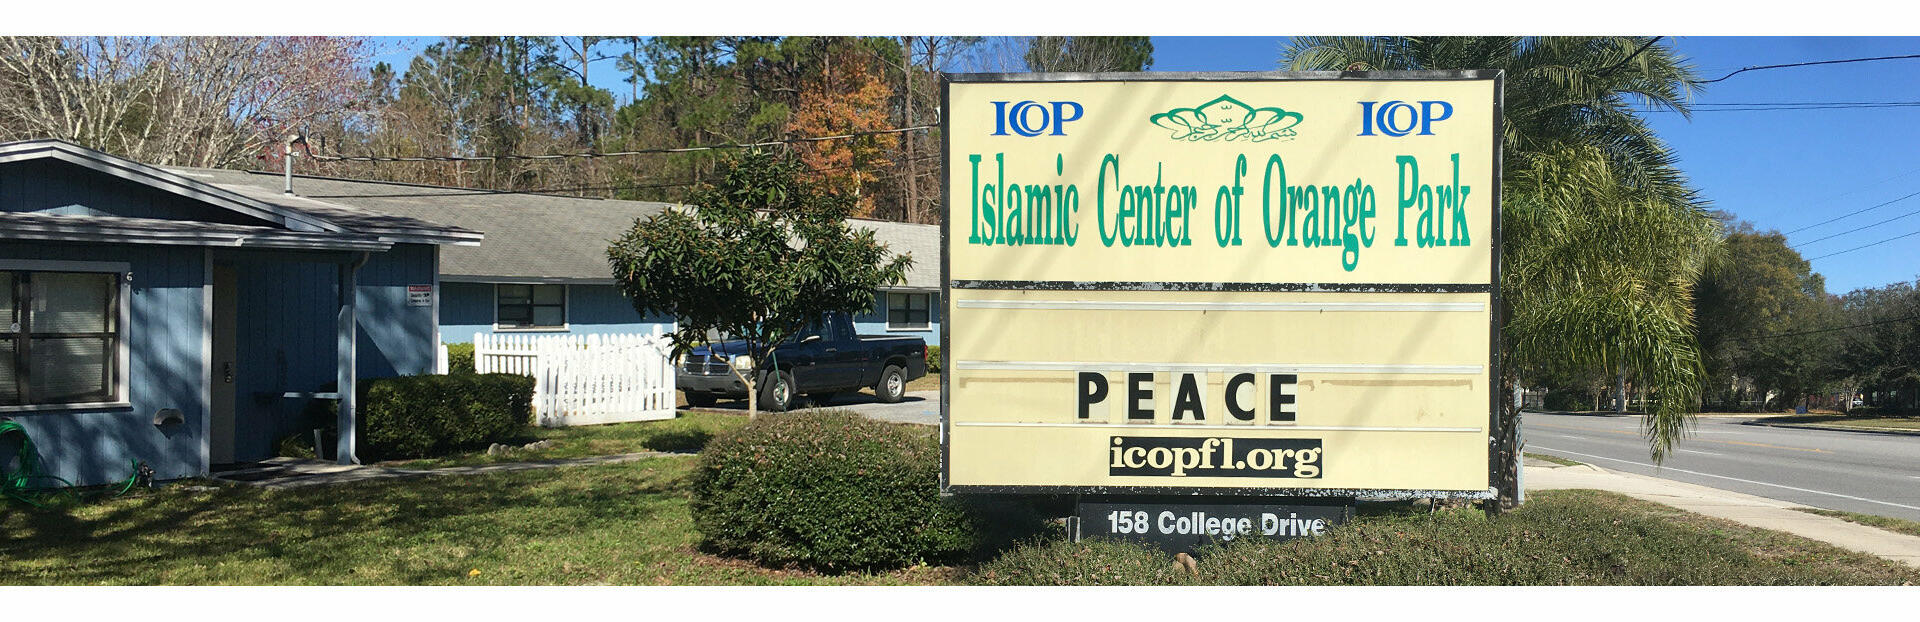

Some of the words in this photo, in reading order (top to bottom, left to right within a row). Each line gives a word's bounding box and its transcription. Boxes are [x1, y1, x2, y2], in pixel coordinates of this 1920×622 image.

[990, 100, 1084, 138] ICOP
[1357, 100, 1454, 138] ICOP
[968, 152, 1079, 248] Islamic
[1096, 152, 1198, 249] Center
[1214, 153, 1247, 249] of
[1261, 153, 1378, 273] Orange
[1394, 152, 1471, 249] Park
[1078, 372, 1298, 422] PEACE
[1107, 510, 1150, 534] 158
[1157, 510, 1252, 541] College
[1261, 512, 1326, 537] Drive
